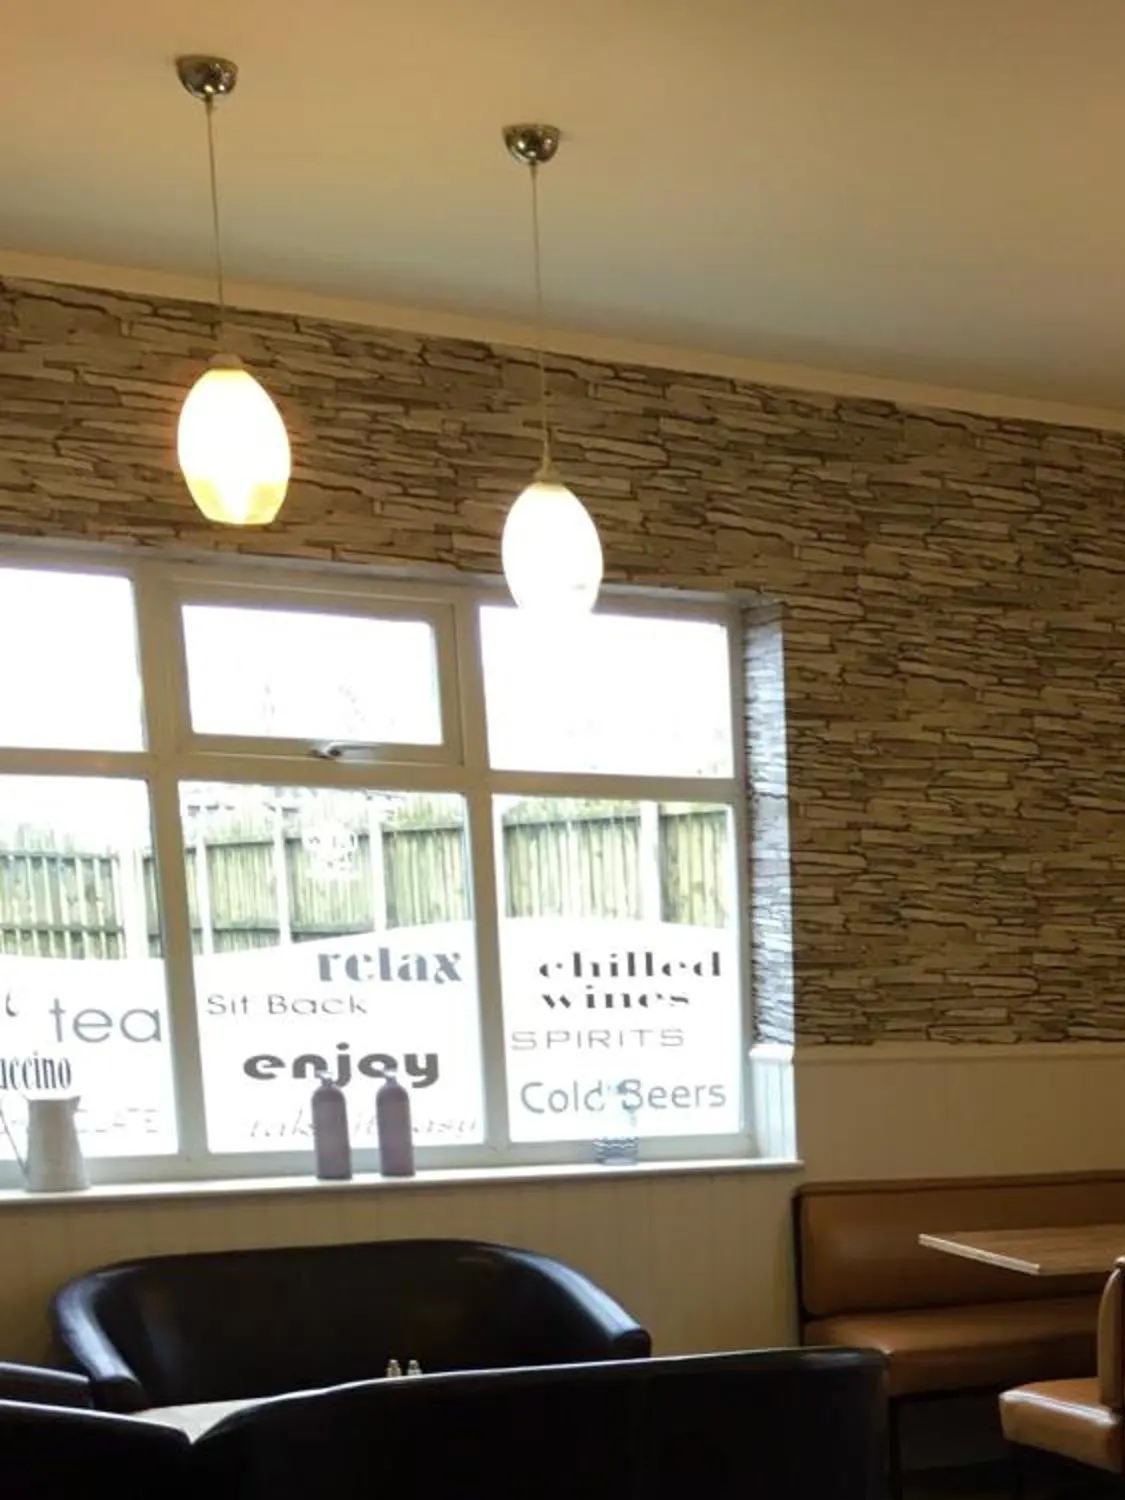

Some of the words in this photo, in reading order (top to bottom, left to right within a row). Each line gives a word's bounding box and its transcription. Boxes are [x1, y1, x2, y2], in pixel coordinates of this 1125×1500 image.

[317, 946, 463, 985] relax
[538, 950, 722, 979] chilled
[207, 994, 249, 1016] Sit
[267, 993, 368, 1016] Back
[541, 983, 691, 1010] wines
[48, 998, 162, 1043] tea
[511, 1028, 685, 1051] SPIRITS
[242, 1041, 440, 1089] enjoy
[520, 1081, 606, 1115] Cold
[619, 1078, 727, 1113] Beers
